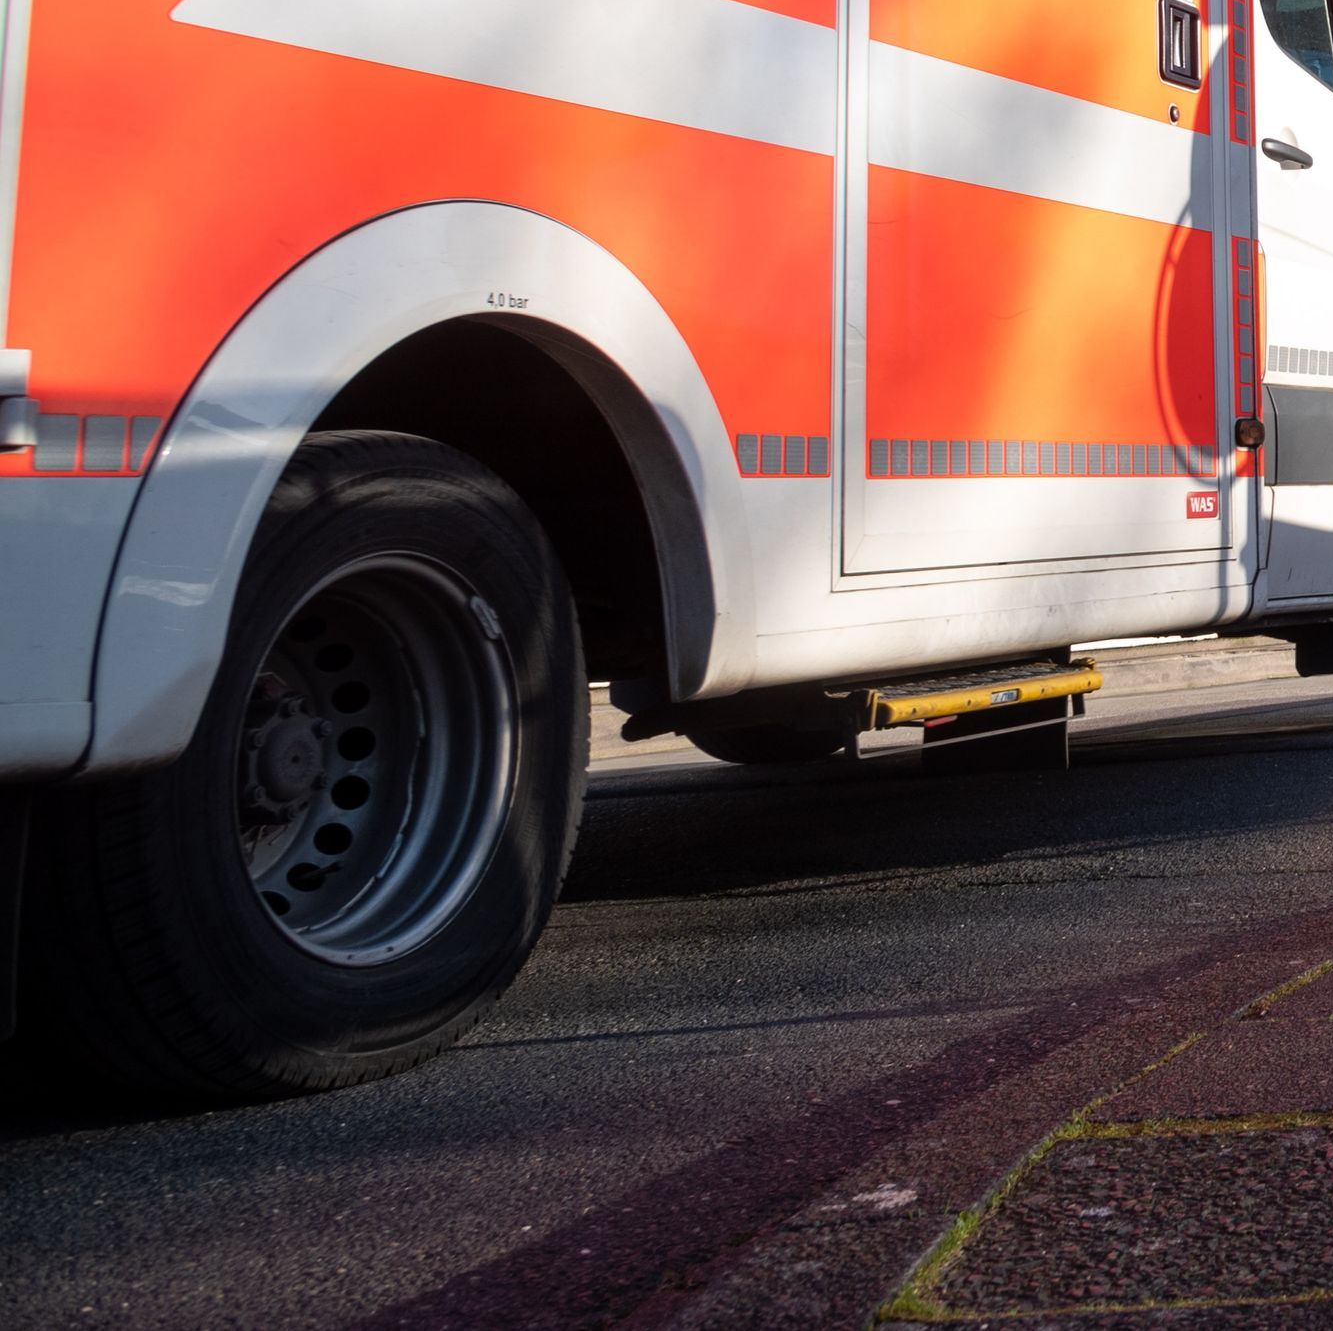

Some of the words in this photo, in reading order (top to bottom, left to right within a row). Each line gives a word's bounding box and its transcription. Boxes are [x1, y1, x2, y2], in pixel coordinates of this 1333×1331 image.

[486, 292, 505, 309] 4,0
[509, 293, 529, 308] bar
[1190, 497, 1214, 512] WAS
